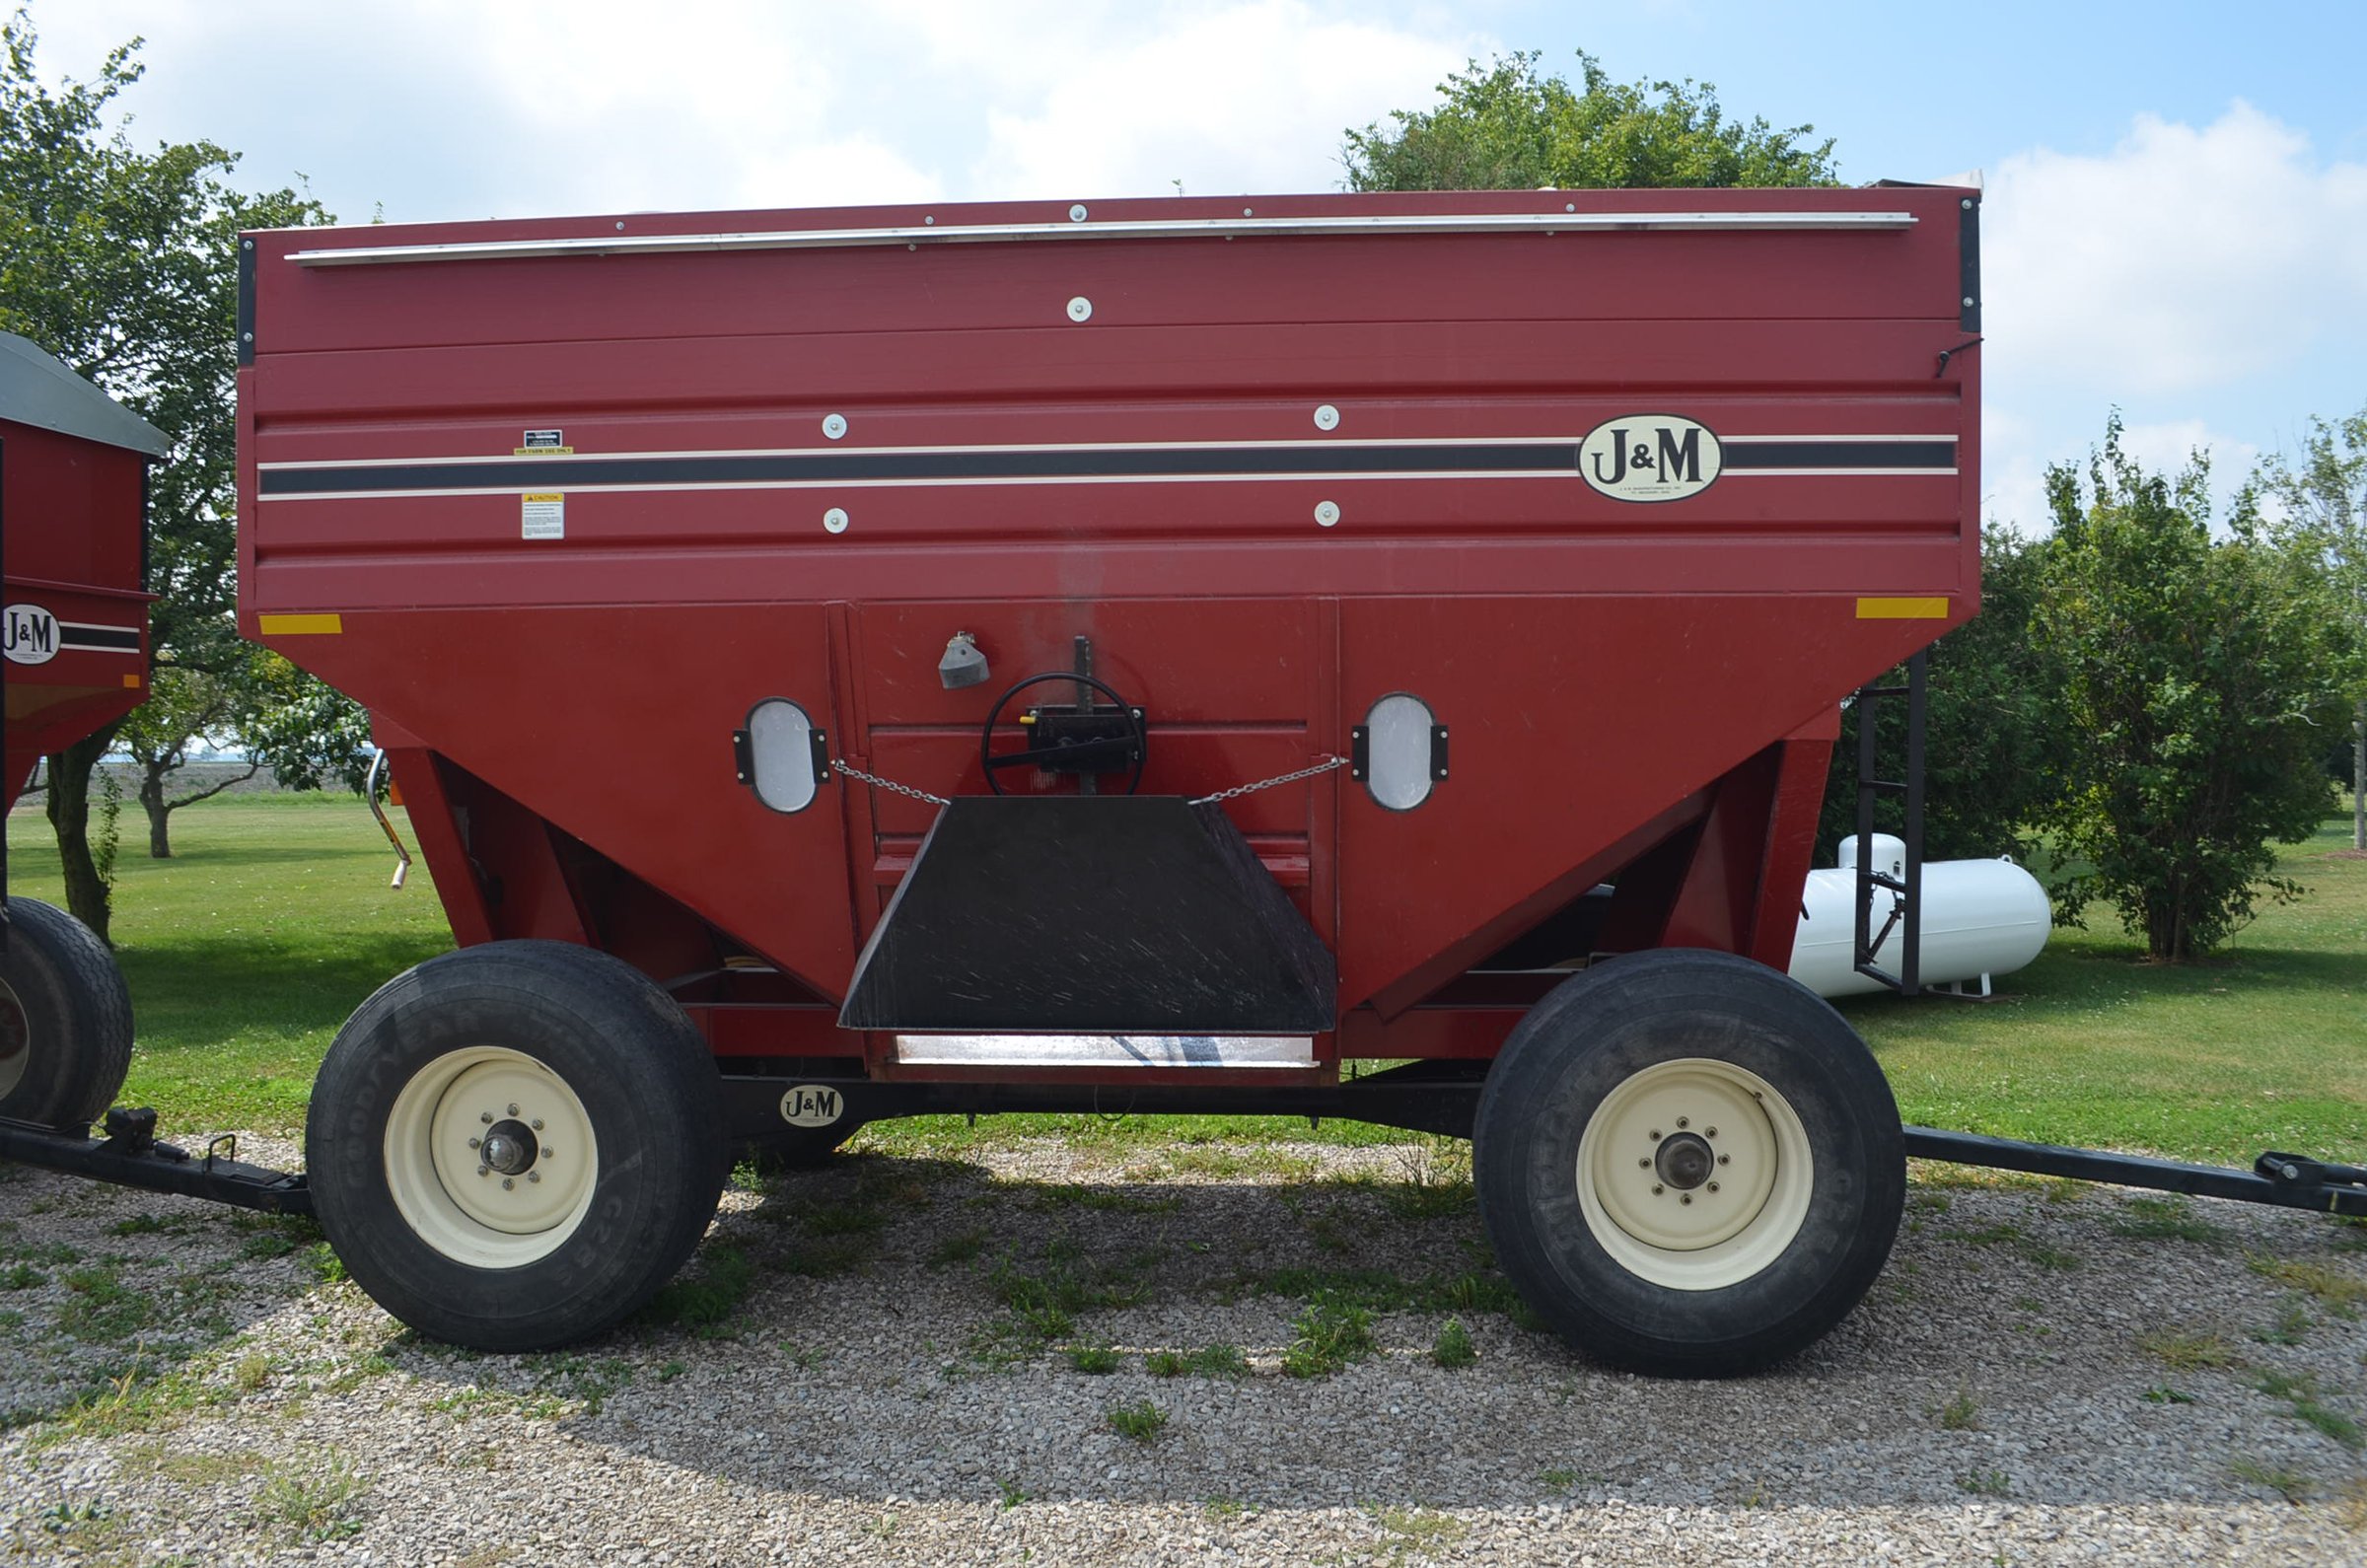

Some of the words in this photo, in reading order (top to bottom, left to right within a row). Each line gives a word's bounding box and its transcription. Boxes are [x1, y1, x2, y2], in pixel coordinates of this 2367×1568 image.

[1591, 428, 1703, 484] J&M
[4, 611, 52, 653] J&M
[786, 1090, 836, 1117] J&M
